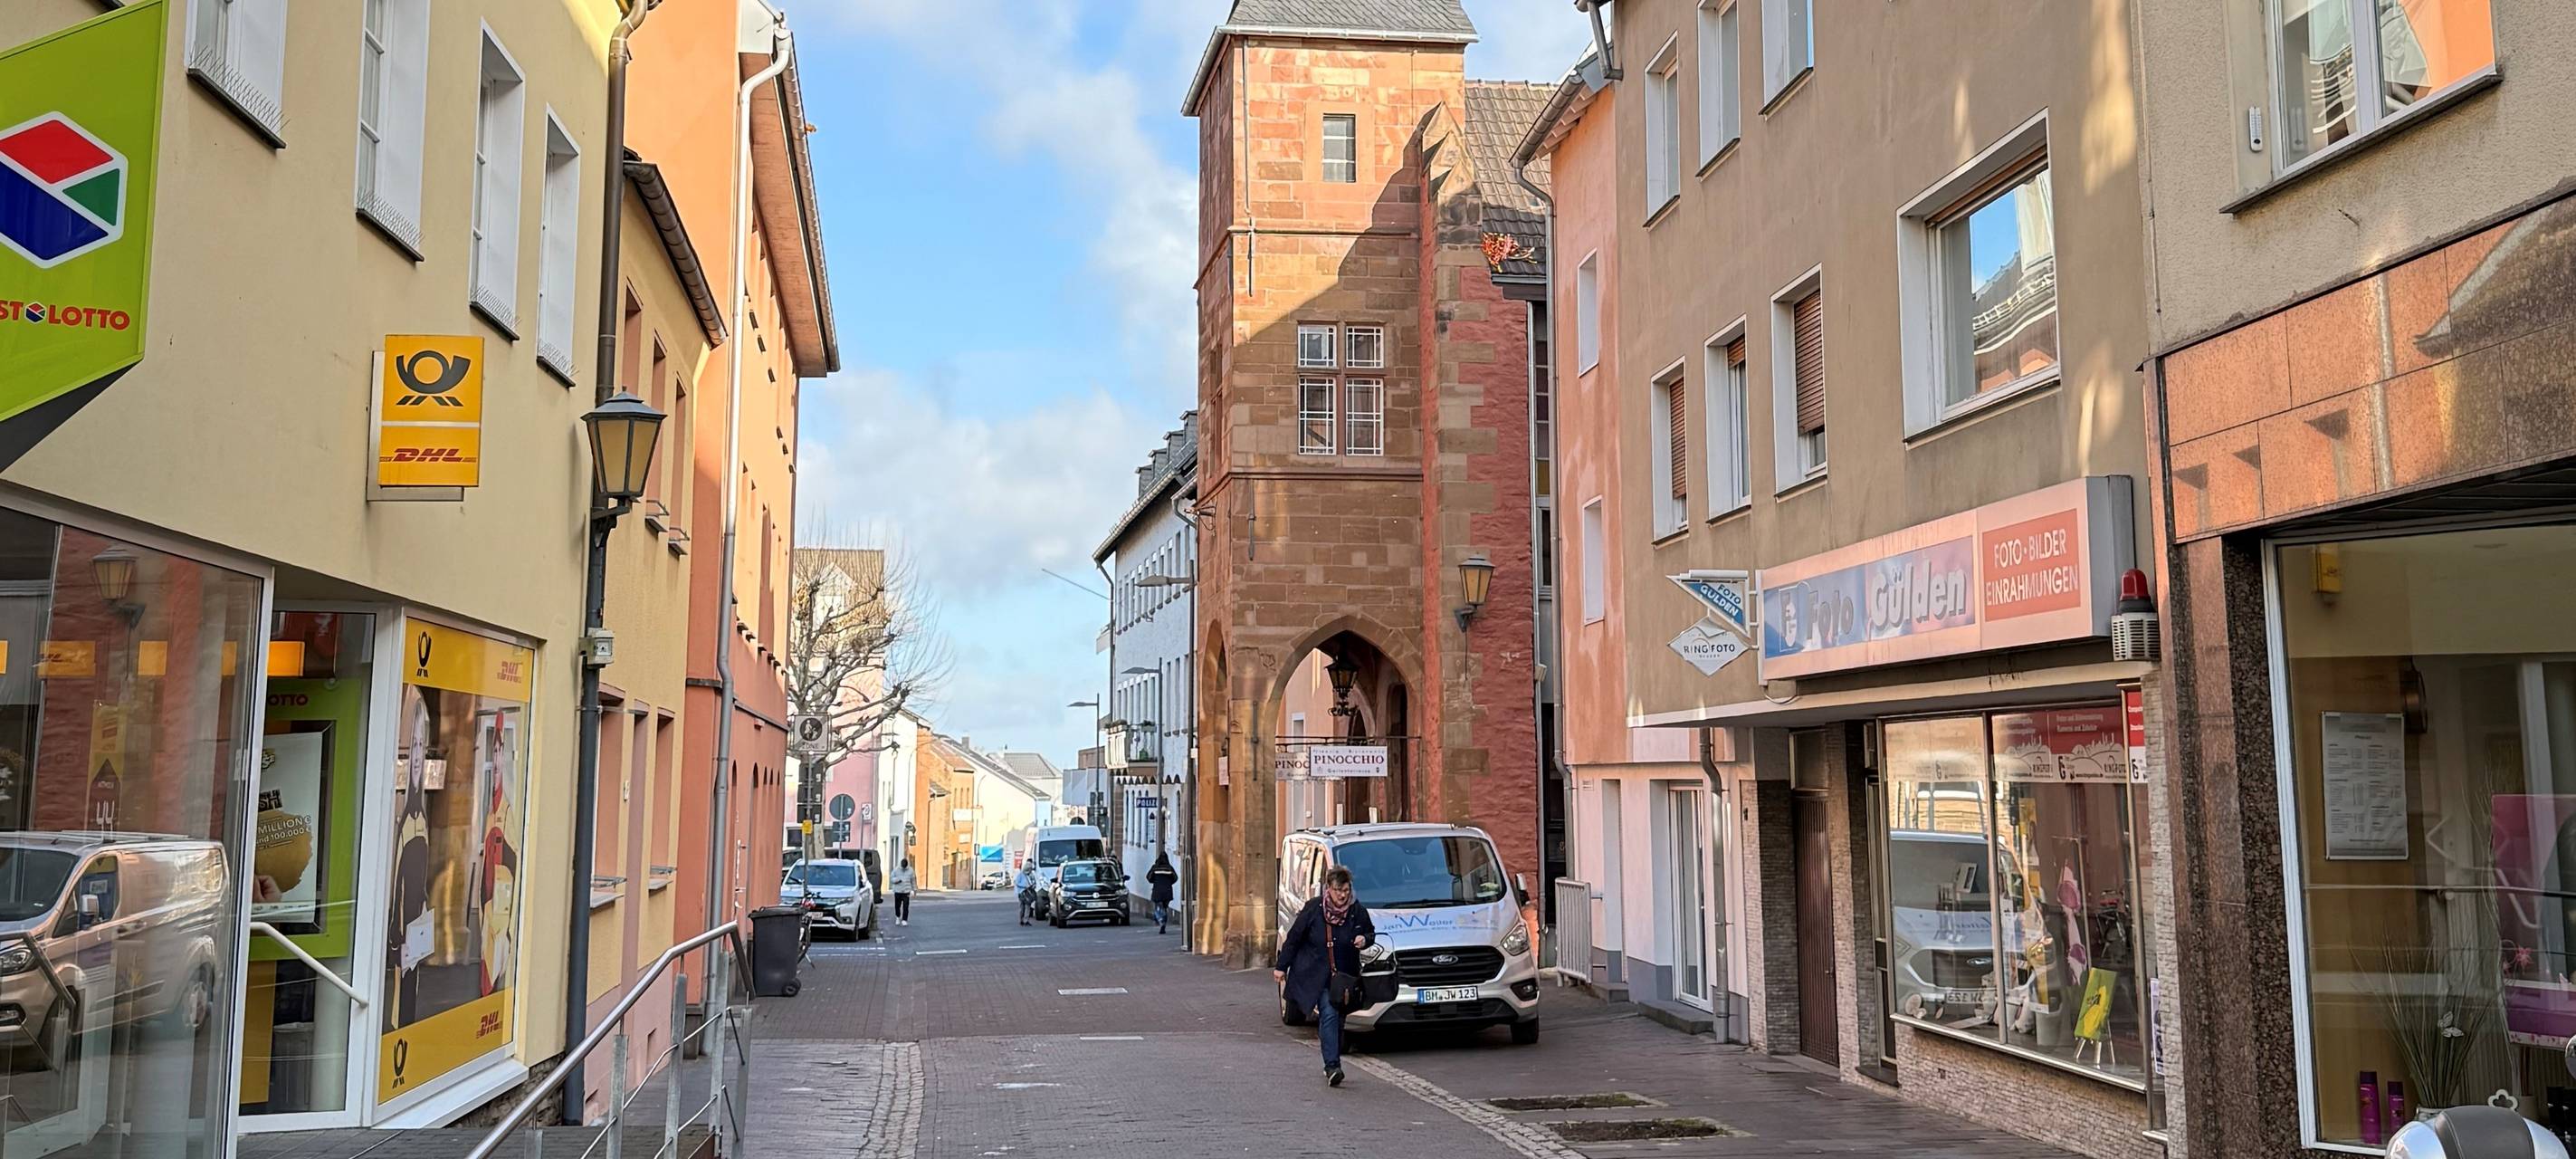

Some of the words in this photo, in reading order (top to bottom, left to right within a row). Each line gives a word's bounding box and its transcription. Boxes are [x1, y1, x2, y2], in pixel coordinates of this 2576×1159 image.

[392, 447, 464, 463] DHL
[1994, 539, 2022, 569] FOTO
[2028, 528, 2066, 561] BILDER
[1717, 584, 1741, 605] FOTO
[1985, 563, 2079, 607] EINRAHMUNGEN
[1807, 589, 1855, 648] Foto
[1867, 560, 1967, 630] Gülden
[498, 660, 523, 684] DHL
[1314, 754, 1385, 765] PINOCCHIO
[1426, 991, 1438, 1001] BM
[1444, 990, 1456, 1001] JW
[1458, 988, 1476, 999] 123
[476, 1010, 502, 1039] DHL
